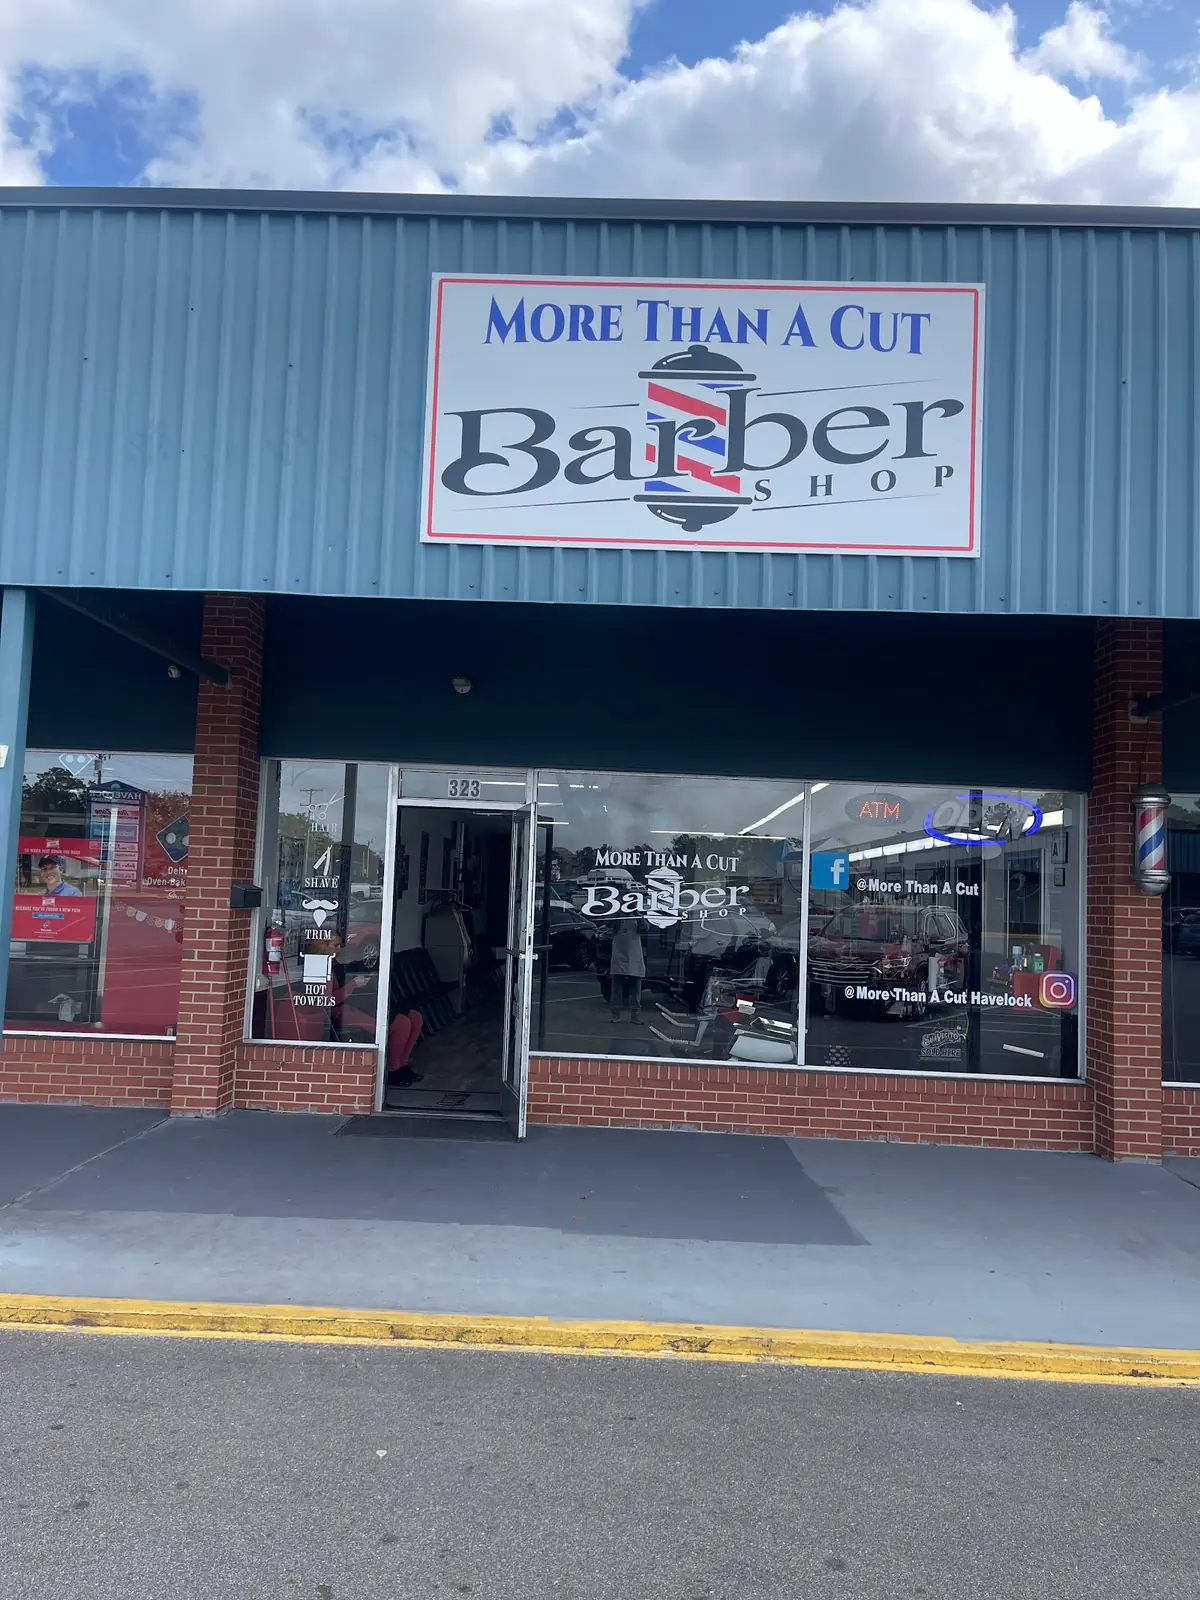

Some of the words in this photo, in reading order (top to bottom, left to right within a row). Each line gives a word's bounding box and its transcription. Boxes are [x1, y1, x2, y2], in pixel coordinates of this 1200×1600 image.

[482, 296, 623, 345] MORE
[636, 299, 771, 346] THAN
[781, 302, 819, 348] A
[829, 304, 931, 355] CUT
[440, 387, 965, 497] Barber
[753, 465, 955, 502] SHOP
[449, 779, 480, 797] 323
[859, 801, 900, 819] ATM
[311, 822, 338, 833] HAIR
[595, 850, 641, 866] MORE
[644, 851, 688, 868] THAN
[691, 852, 703, 869] A
[706, 854, 740, 872] CUT
[304, 877, 339, 888] SHAVE
[856, 878, 902, 893] @More
[905, 880, 938, 895] Than
[942, 882, 952, 895] A
[955, 882, 979, 896] Cut
[580, 881, 750, 917] Barber
[681, 907, 747, 920] SHOP
[304, 929, 332, 940] TRIM
[304, 984, 327, 995] HOT
[844, 986, 890, 1001] @More
[893, 988, 926, 1003] Than
[930, 990, 940, 1003] A
[944, 990, 967, 1004] Cut
[970, 992, 1032, 1008] Havelock
[293, 995, 336, 1007] TOWELS
